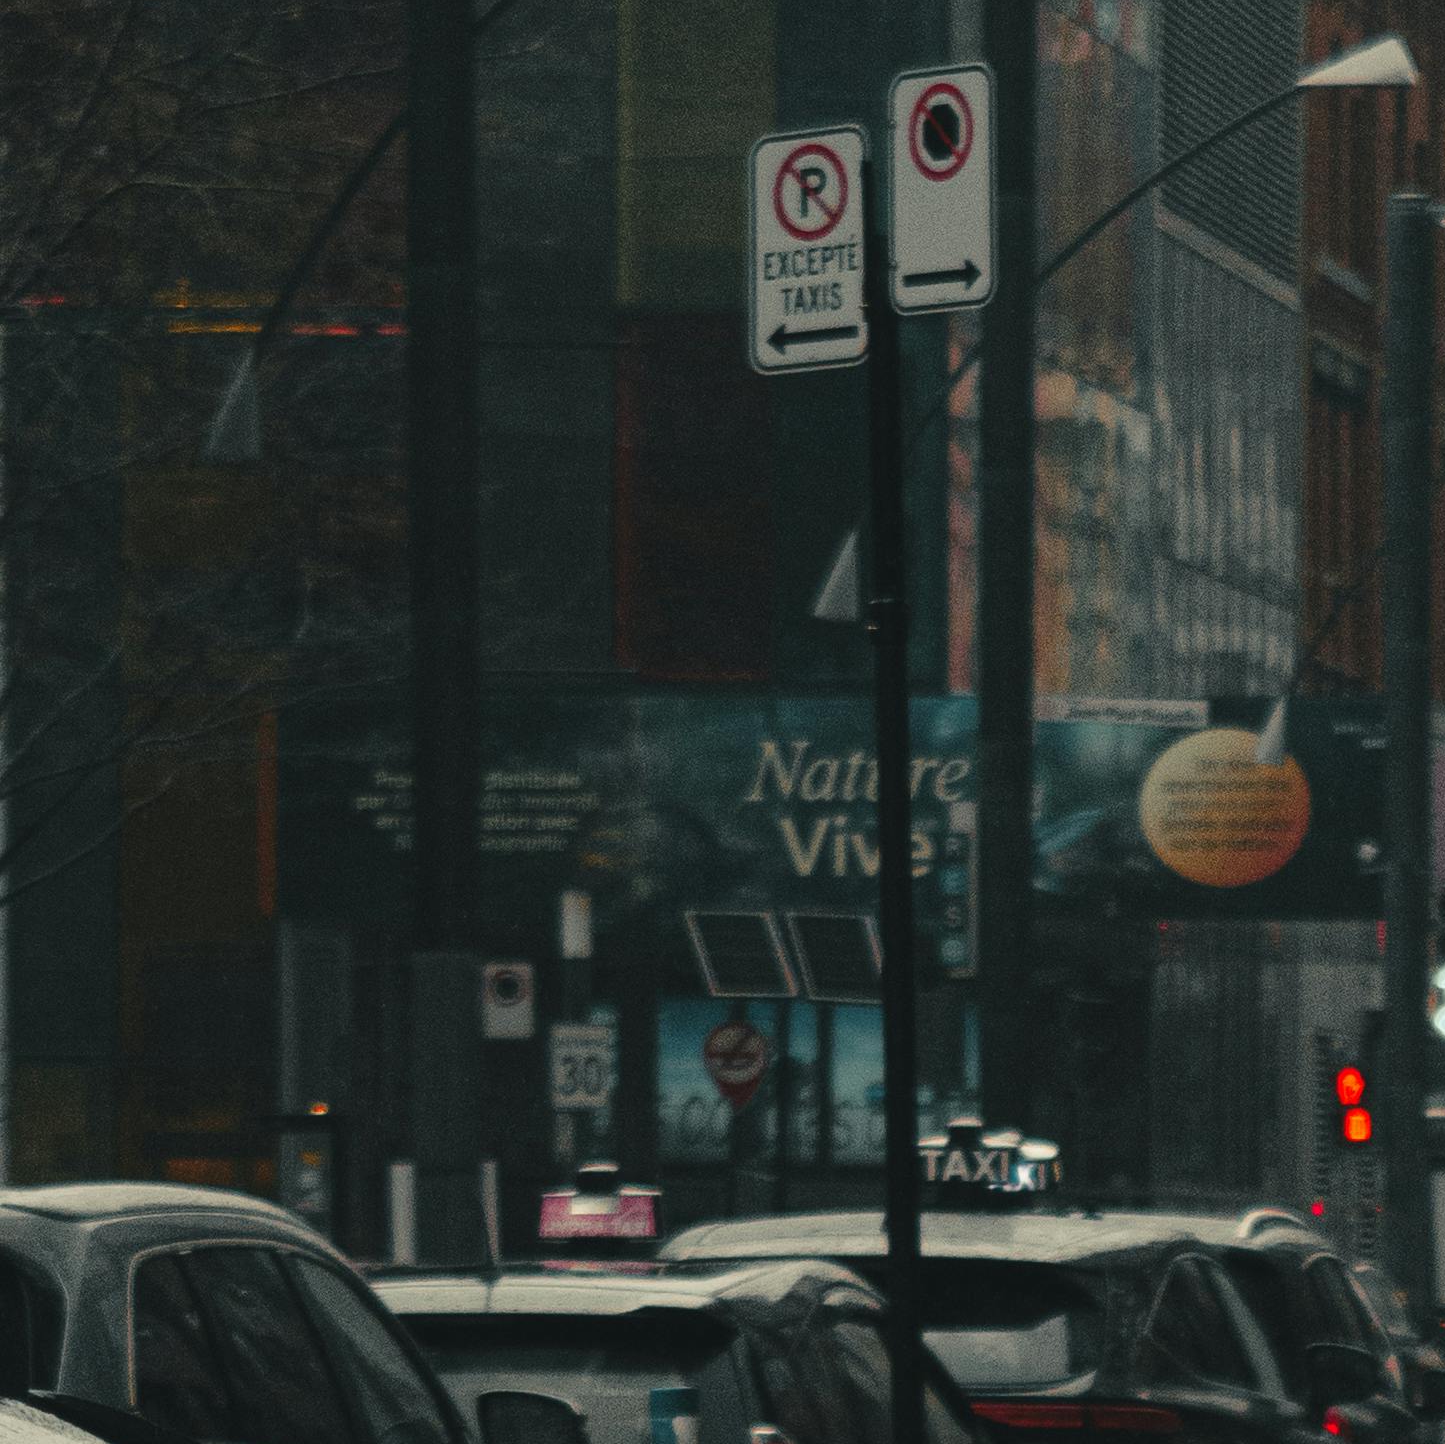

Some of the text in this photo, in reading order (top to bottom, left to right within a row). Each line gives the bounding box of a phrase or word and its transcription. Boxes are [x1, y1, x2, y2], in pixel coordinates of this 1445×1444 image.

[762, 235, 857, 281] EXCEPTÉ
[783, 284, 844, 316] TAXIS
[559, 1055, 604, 1095] 30
[917, 1149, 1010, 1182] TAXI
